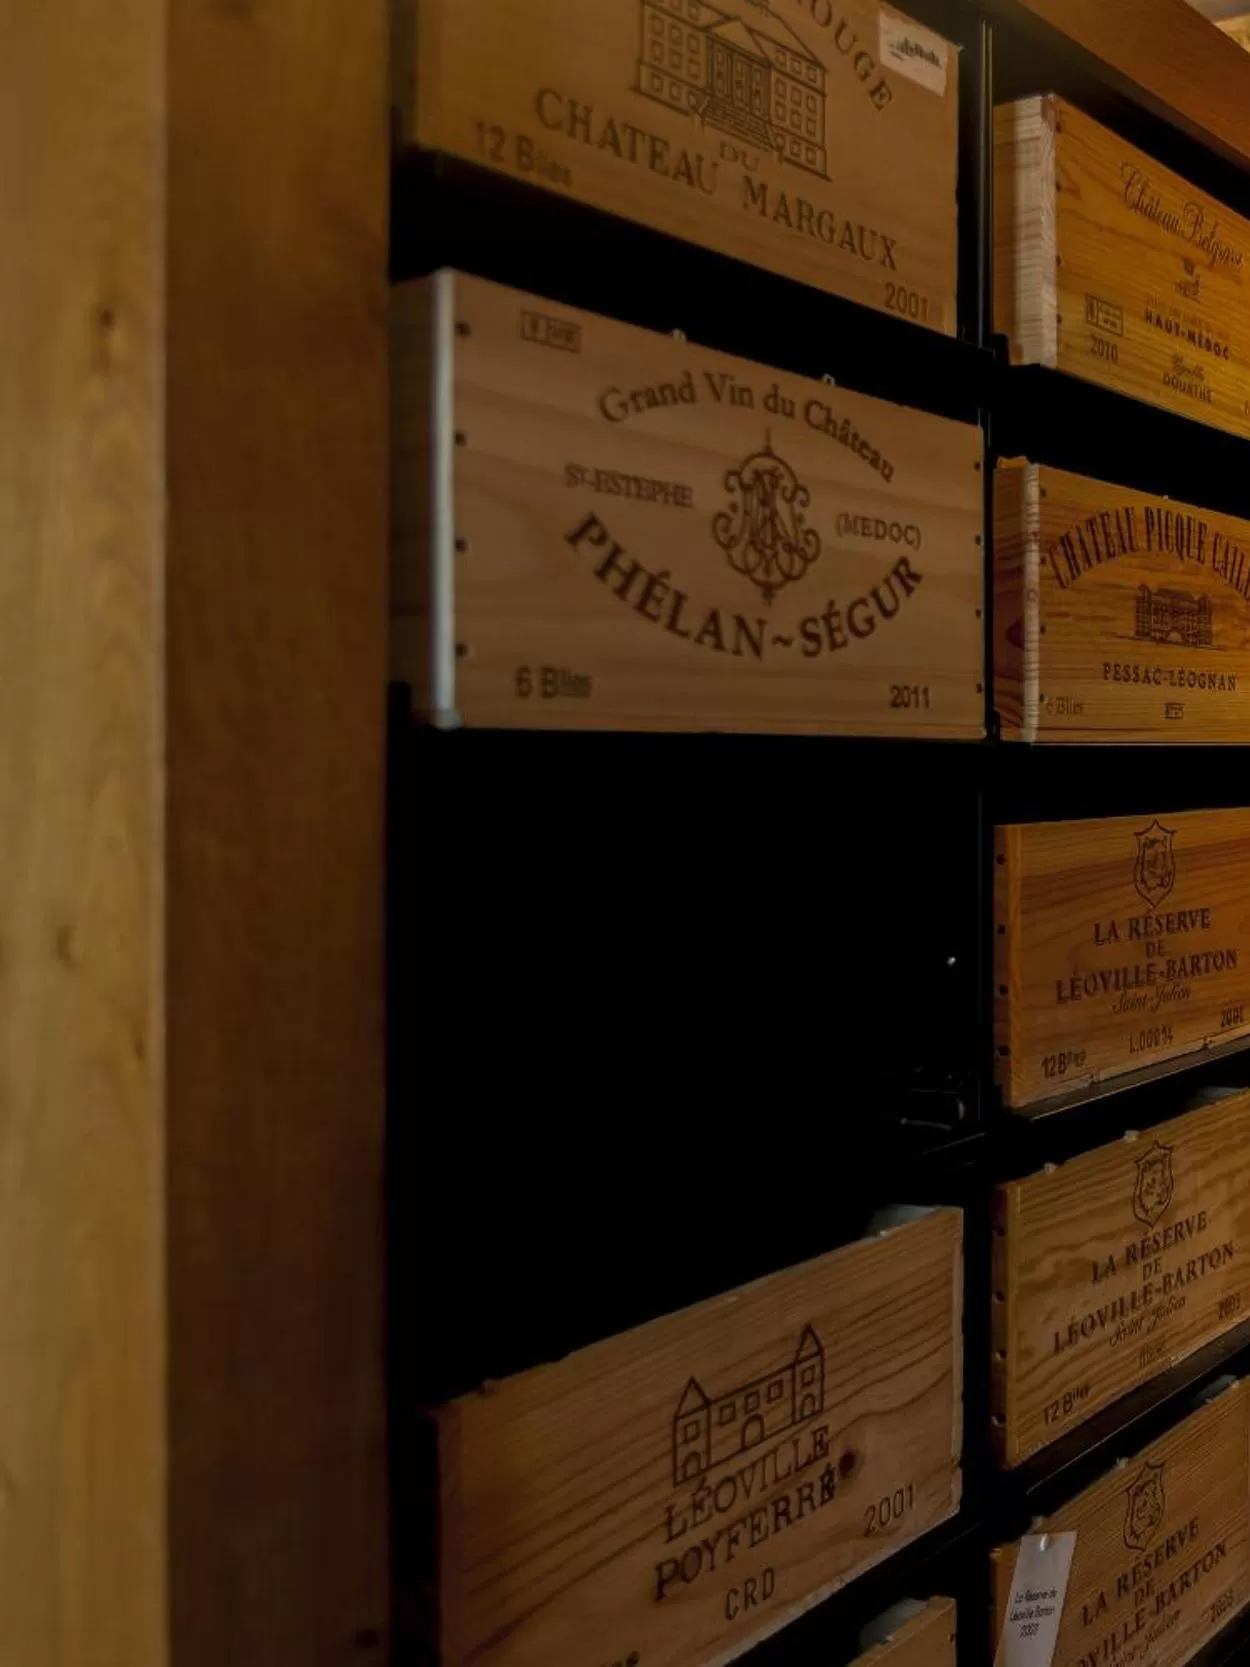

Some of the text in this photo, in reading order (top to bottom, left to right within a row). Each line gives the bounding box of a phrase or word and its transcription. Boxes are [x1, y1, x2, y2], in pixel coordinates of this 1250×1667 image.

[797, 0, 893, 110] OUGE
[475, 121, 505, 163] 12
[719, 140, 760, 172] DU
[534, 87, 897, 272] CHATEAU MARGAUX
[884, 281, 930, 323] 2001
[1090, 333, 1119, 363] 2010
[1163, 371, 1215, 404] DOURTHE
[600, 369, 896, 484] Grand Vin du Château
[1144, 506, 1209, 566] PIQUE
[514, 666, 533, 698] 6
[890, 685, 931, 709] 2011
[1094, 907, 1211, 946] LA RÉSERVE
[1145, 941, 1166, 958] DE
[1055, 948, 1240, 1005] LÉOVILLE-BARTON
[1091, 1210, 1208, 1285] LA RÉSERVE
[1142, 1255, 1162, 1281] DE
[663, 1423, 830, 1545] LÉOVILLE
[652, 1461, 837, 1605] POYFERRÉ
[863, 1483, 918, 1539] 2001
[723, 1566, 777, 1623] CRD
[1082, 1514, 1200, 1627] LA RÉSERVE
[1134, 1578, 1155, 1609] DE
